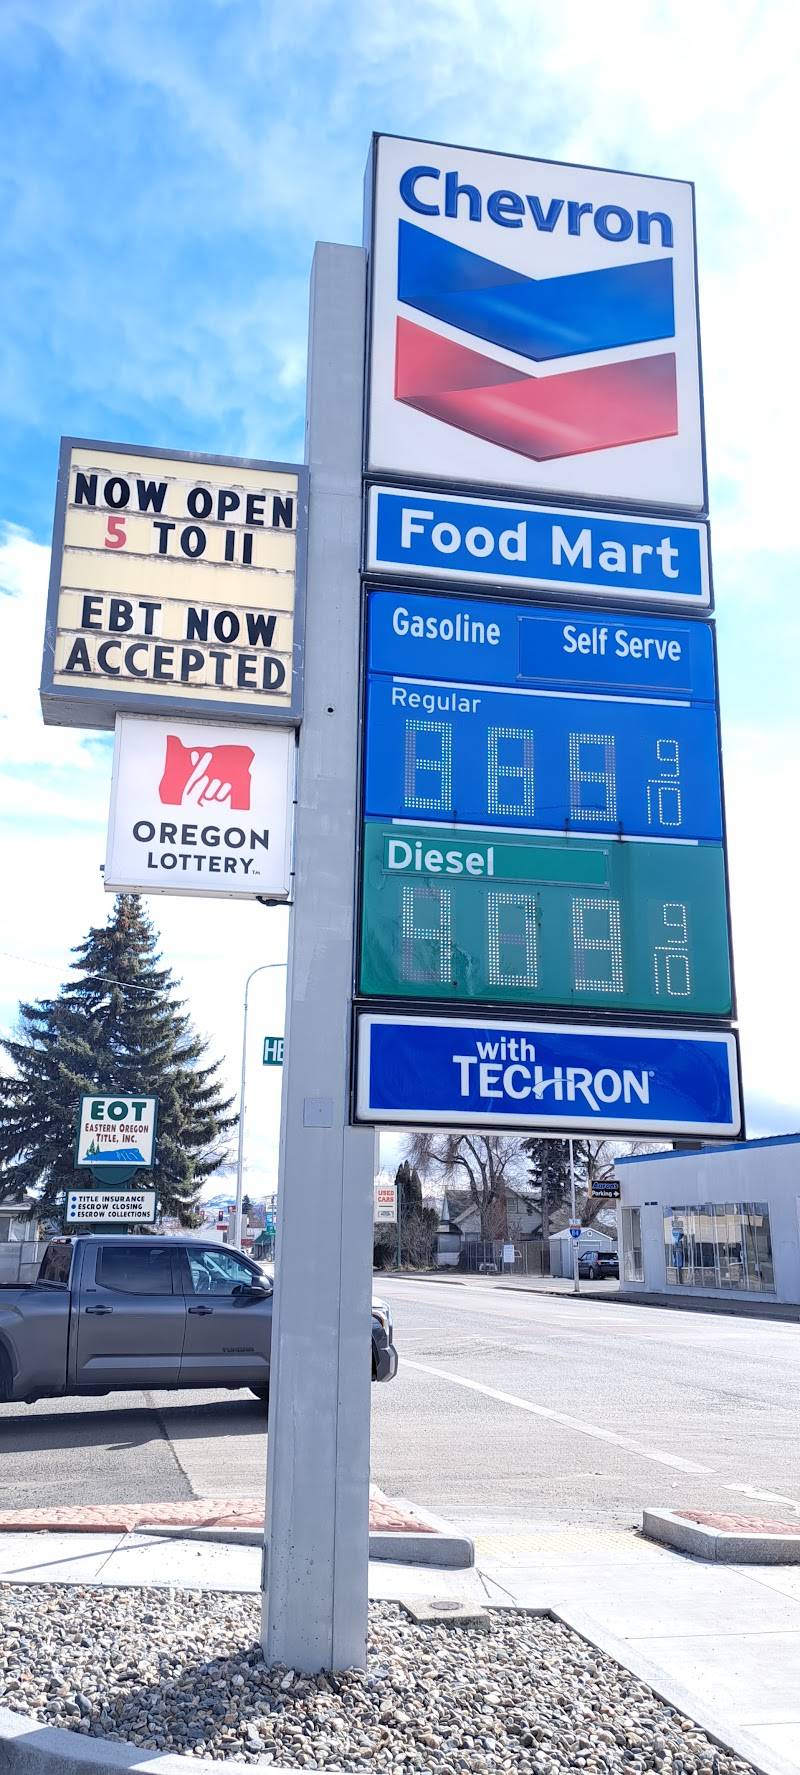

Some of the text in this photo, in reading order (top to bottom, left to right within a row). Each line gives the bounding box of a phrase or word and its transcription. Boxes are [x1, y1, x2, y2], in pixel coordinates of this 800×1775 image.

[398, 165, 674, 248] Chevron
[74, 472, 293, 528] NOW OPEN
[104, 516, 127, 549] 5
[153, 521, 206, 557] TO
[400, 508, 680, 579] Food Mart
[81, 595, 277, 648] EBT NOW
[392, 607, 682, 661] Gasoline Self Serve
[65, 637, 286, 690] ACCEPTED
[391, 687, 482, 713] Regular
[132, 820, 270, 851] OREGON
[147, 851, 254, 875] LOTTERY
[388, 840, 494, 876] Diesel
[476, 1037, 536, 1062] with
[452, 1055, 651, 1112] TECHRON
[90, 1100, 147, 1121] EOT
[84, 1122, 149, 1134] EASTERN OREGON
[77, 1203, 143, 1211] ESCROW CLOSING
[78, 1195, 146, 1203] TITLE INSURANCE
[592, 1190, 613, 1198] Parking
